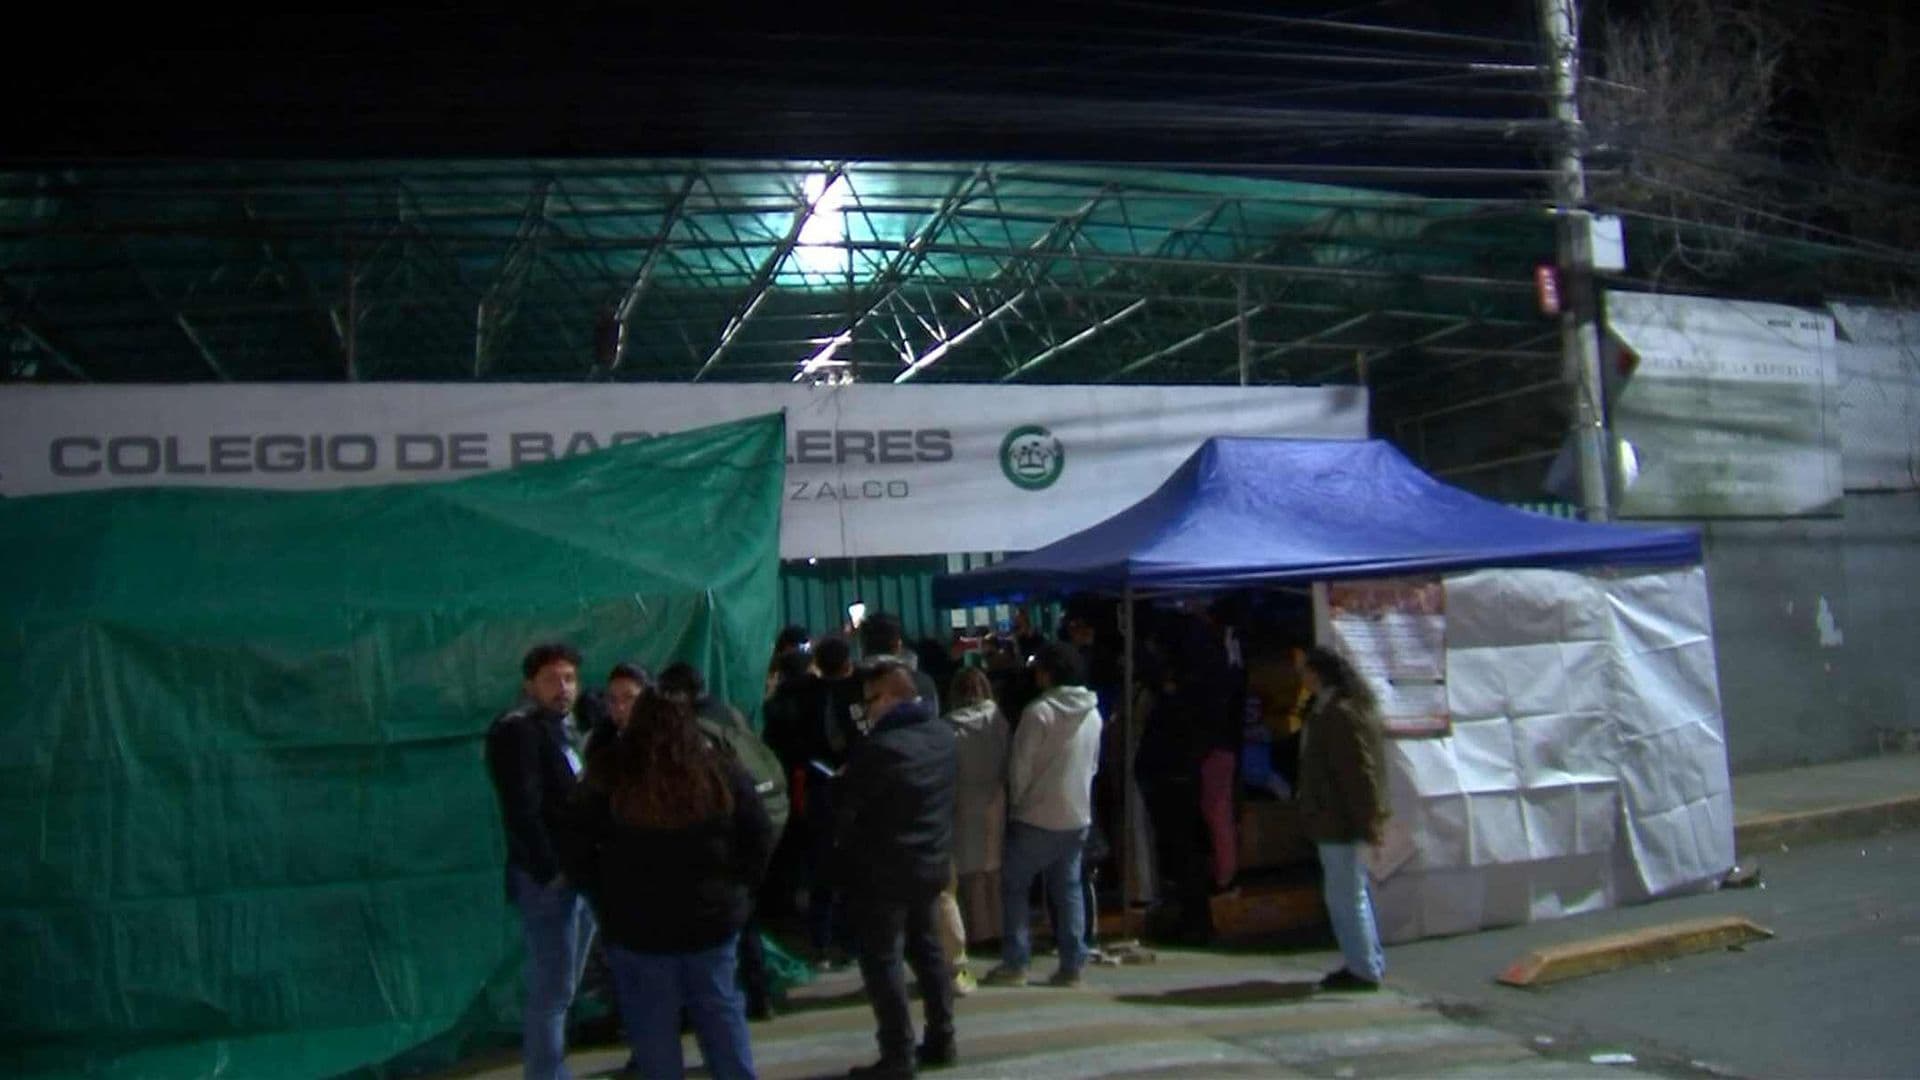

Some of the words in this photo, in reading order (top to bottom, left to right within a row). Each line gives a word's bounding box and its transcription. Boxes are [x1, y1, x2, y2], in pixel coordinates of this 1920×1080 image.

[49, 434, 378, 476] COLEGIO
[395, 432, 488, 470] DE
[789, 479, 909, 501] ZALCO
